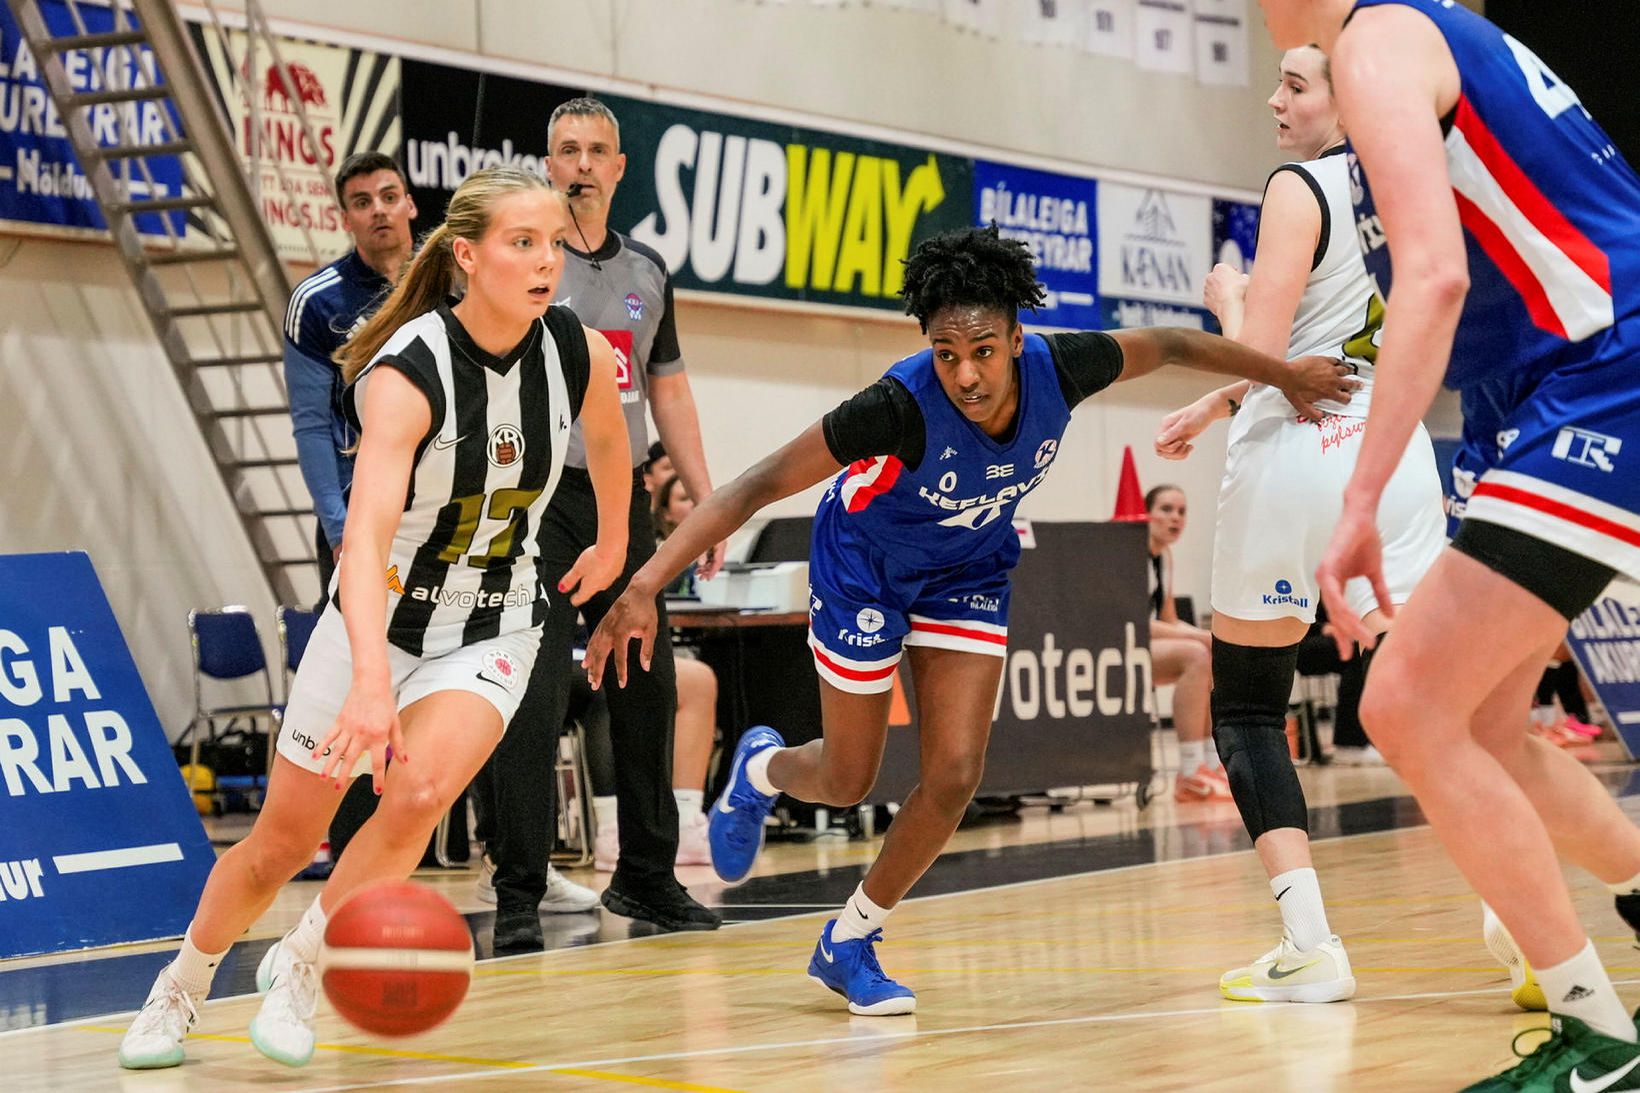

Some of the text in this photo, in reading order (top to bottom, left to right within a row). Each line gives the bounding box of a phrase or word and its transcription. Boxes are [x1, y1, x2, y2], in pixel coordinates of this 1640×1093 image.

[0, 81, 165, 146] URERAR
[630, 124, 945, 299] SUBWAY
[491, 427, 520, 463] KR
[438, 488, 543, 569] 17
[411, 584, 531, 609] alvotech
[1263, 594, 1308, 608] Kristall
[0, 710, 148, 796] RAR
